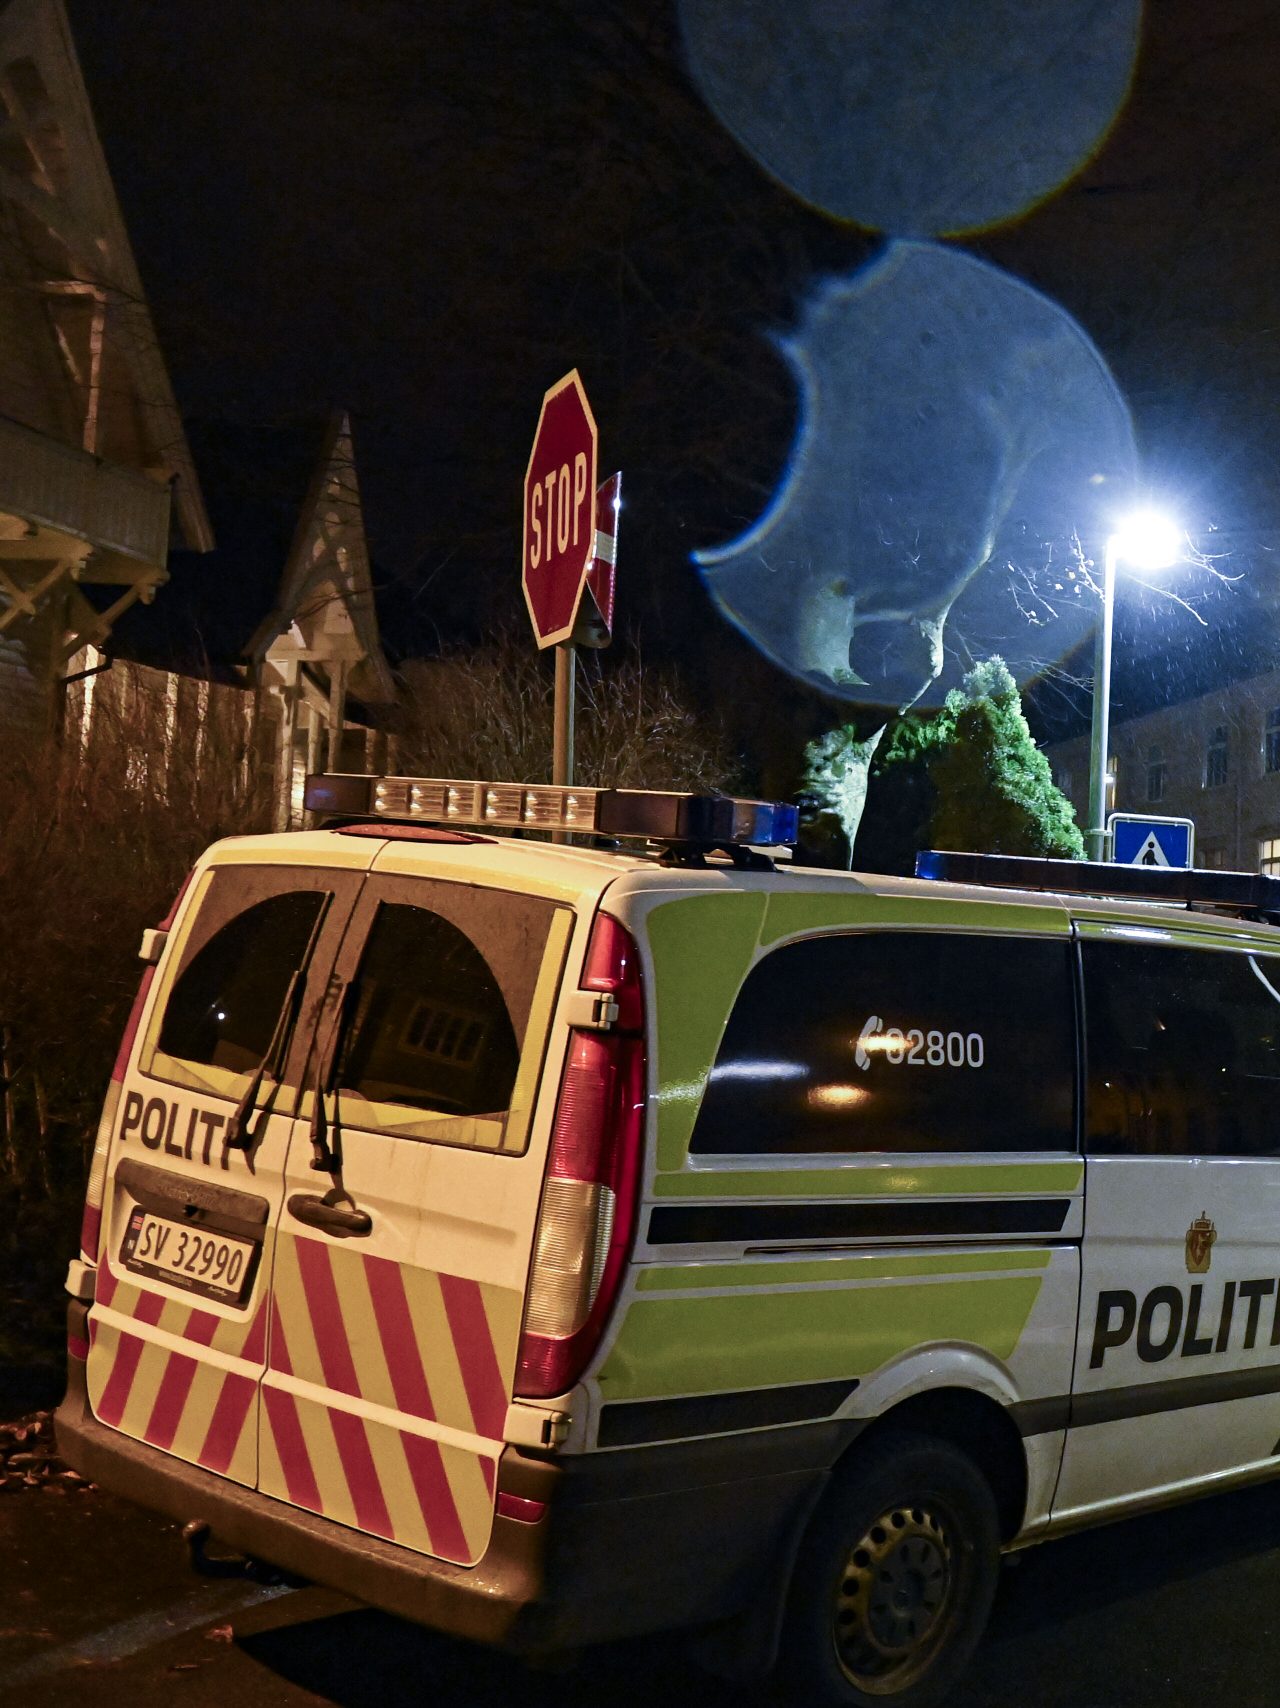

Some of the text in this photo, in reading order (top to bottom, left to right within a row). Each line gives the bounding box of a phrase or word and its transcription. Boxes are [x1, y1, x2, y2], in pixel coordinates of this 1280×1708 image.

[530, 451, 587, 569] STOP
[885, 1027, 984, 1068] 02800
[139, 1221, 243, 1286] SV 32990
